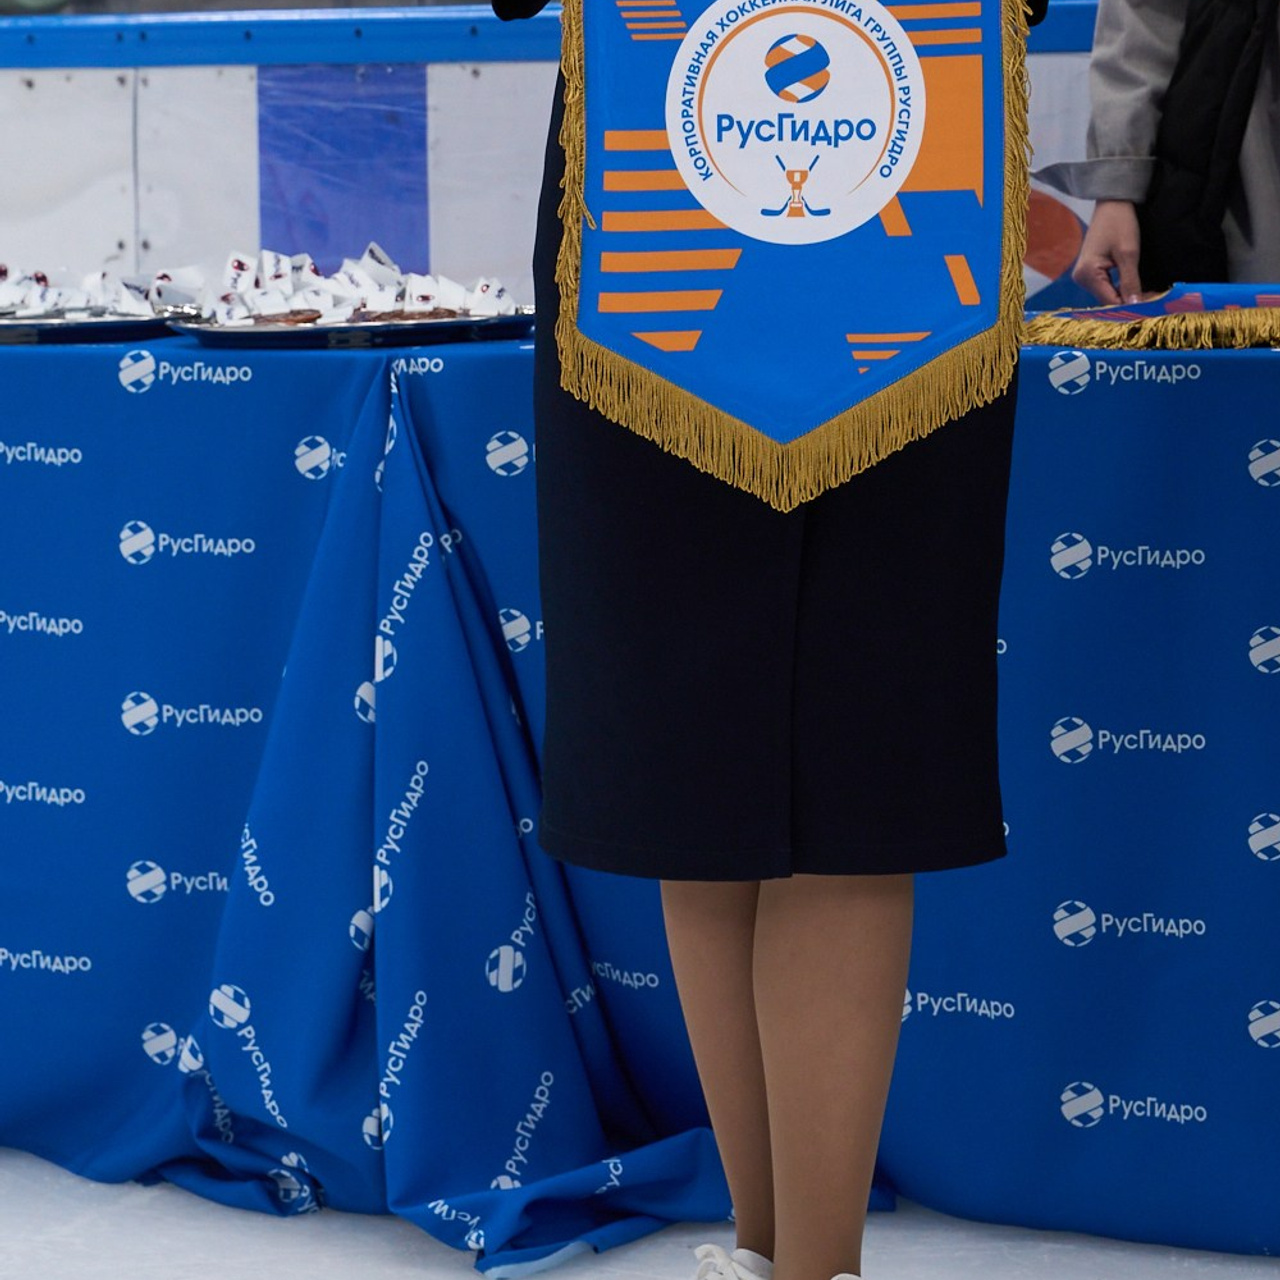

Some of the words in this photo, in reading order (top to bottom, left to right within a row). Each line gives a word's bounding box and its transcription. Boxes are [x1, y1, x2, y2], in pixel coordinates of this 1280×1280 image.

[864, 15, 908, 81] ГРУППЫ
[681, 30, 718, 181] КОРПОРАТИВНАЯ
[717, 113, 877, 148] РусГидро
[879, 85, 911, 178] РУСГИДРО
[158, 361, 253, 385] РусГидро
[1095, 360, 1201, 385] РусГидро
[158, 533, 256, 557] РусГидро
[1097, 545, 1206, 570] РусГидро
[377, 531, 434, 638] РусГидро
[162, 704, 263, 728] РусГидро
[1098, 729, 1206, 754] РусГидро
[374, 760, 429, 867] РусГидро
[170, 871, 228, 894] РусГи
[1101, 912, 1206, 939] РусГидро
[916, 992, 1015, 1020] РусГидро
[379, 990, 427, 1098] РусГидро
[235, 1022, 288, 1128] РусГидро
[503, 1071, 554, 1178] РусГидро
[1108, 1094, 1207, 1125] РусГидро
